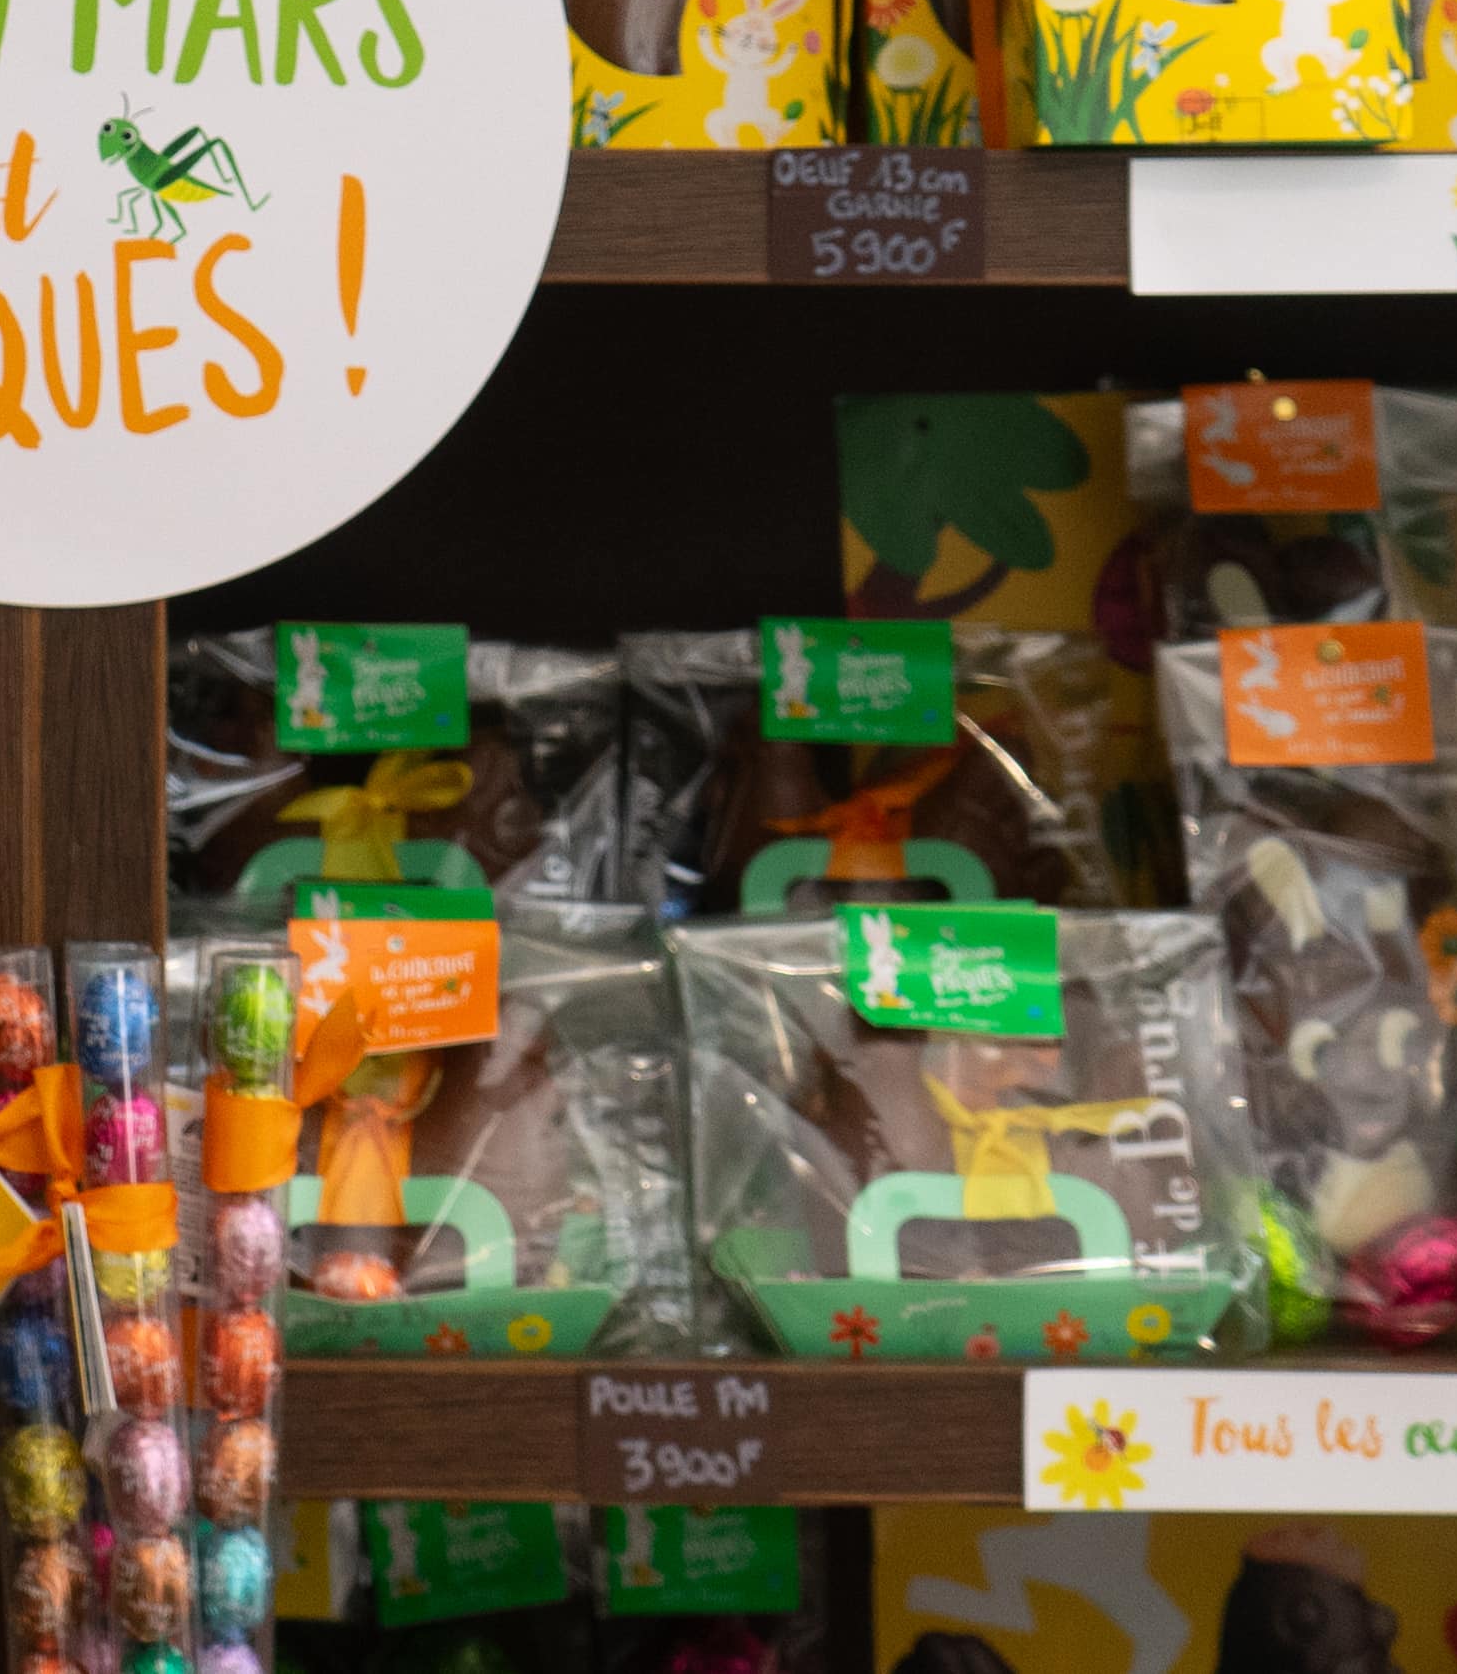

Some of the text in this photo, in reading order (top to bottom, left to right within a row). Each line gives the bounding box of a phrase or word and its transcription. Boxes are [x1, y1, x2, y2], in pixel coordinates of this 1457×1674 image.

[777, 150, 859, 188] OEUF
[337, 172, 369, 398] !
[587, 1373, 700, 1417] POULE
[1187, 1395, 1293, 1459] Tous
[1317, 1397, 1384, 1459] les
